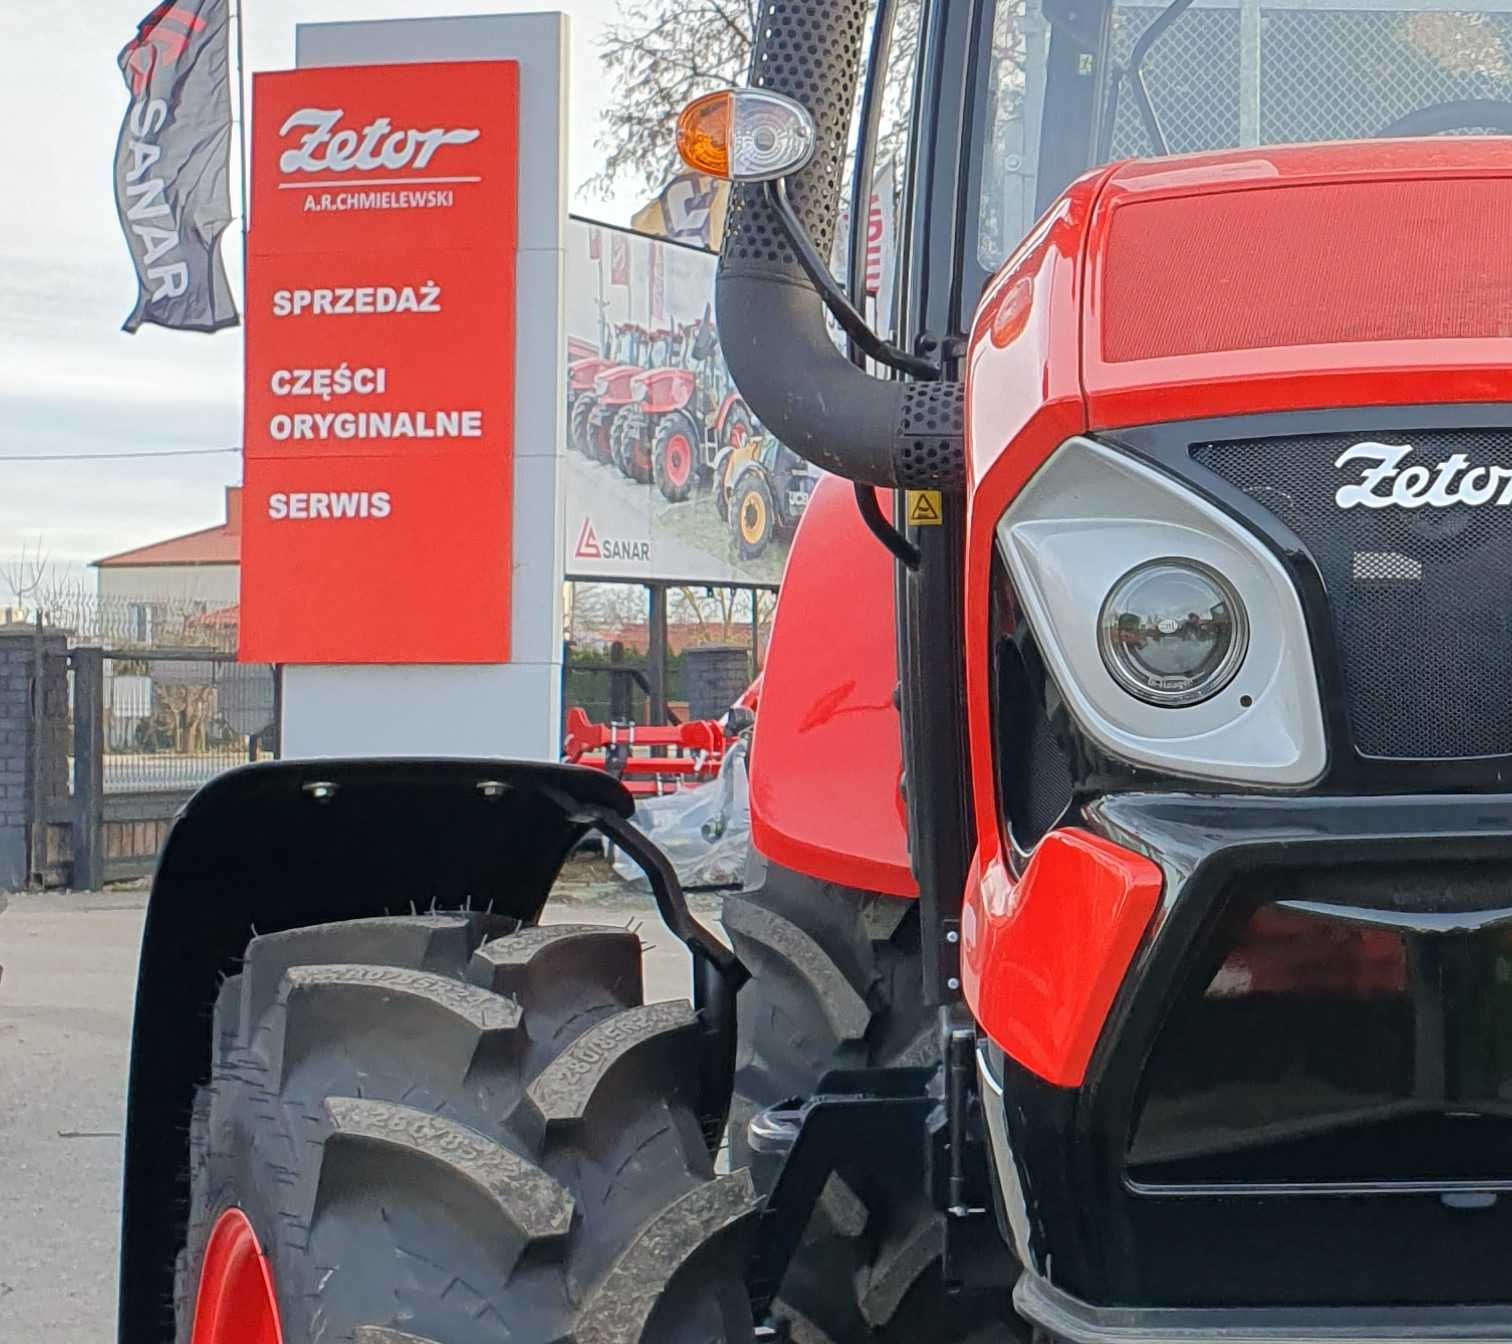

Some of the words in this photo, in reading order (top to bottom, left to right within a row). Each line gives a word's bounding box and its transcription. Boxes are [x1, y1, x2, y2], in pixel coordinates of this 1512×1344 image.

[278, 107, 481, 174] Zetor
[126, 97, 190, 301] SANAR
[304, 190, 454, 212] A.R.CHMIELEWSKI
[272, 280, 441, 316] SPRZEDAŻ
[271, 364, 387, 400] CZĘŚCI
[270, 410, 482, 440] ORYGINALNE
[268, 491, 392, 520] SERWIS
[601, 541, 650, 561] SANAR
